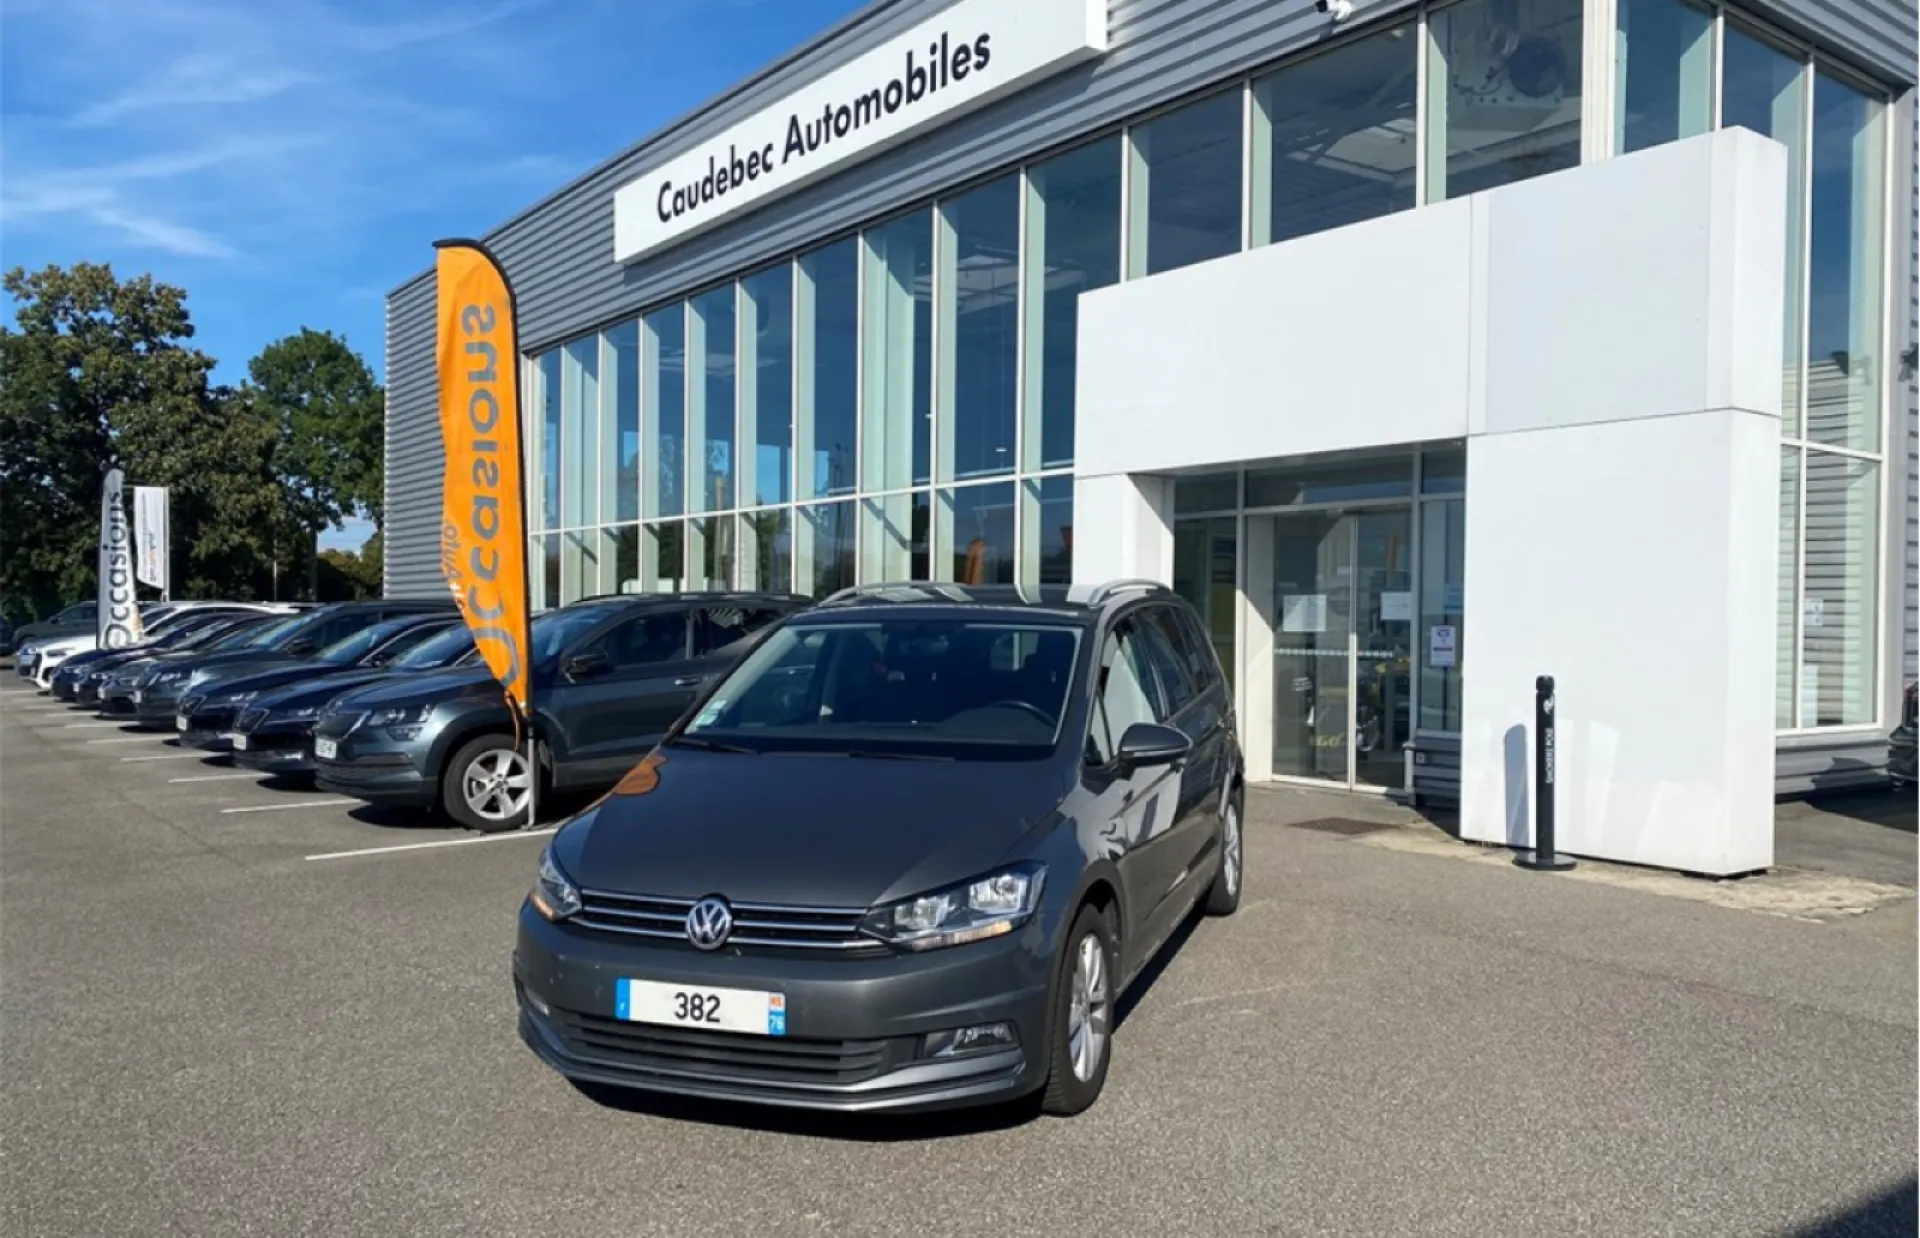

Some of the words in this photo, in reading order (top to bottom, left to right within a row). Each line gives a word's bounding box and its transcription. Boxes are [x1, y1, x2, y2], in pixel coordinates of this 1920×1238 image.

[656, 144, 774, 223] Caudebec
[781, 31, 992, 165] Automobiles
[103, 491, 132, 649] Occasions
[673, 991, 721, 1023] 382
